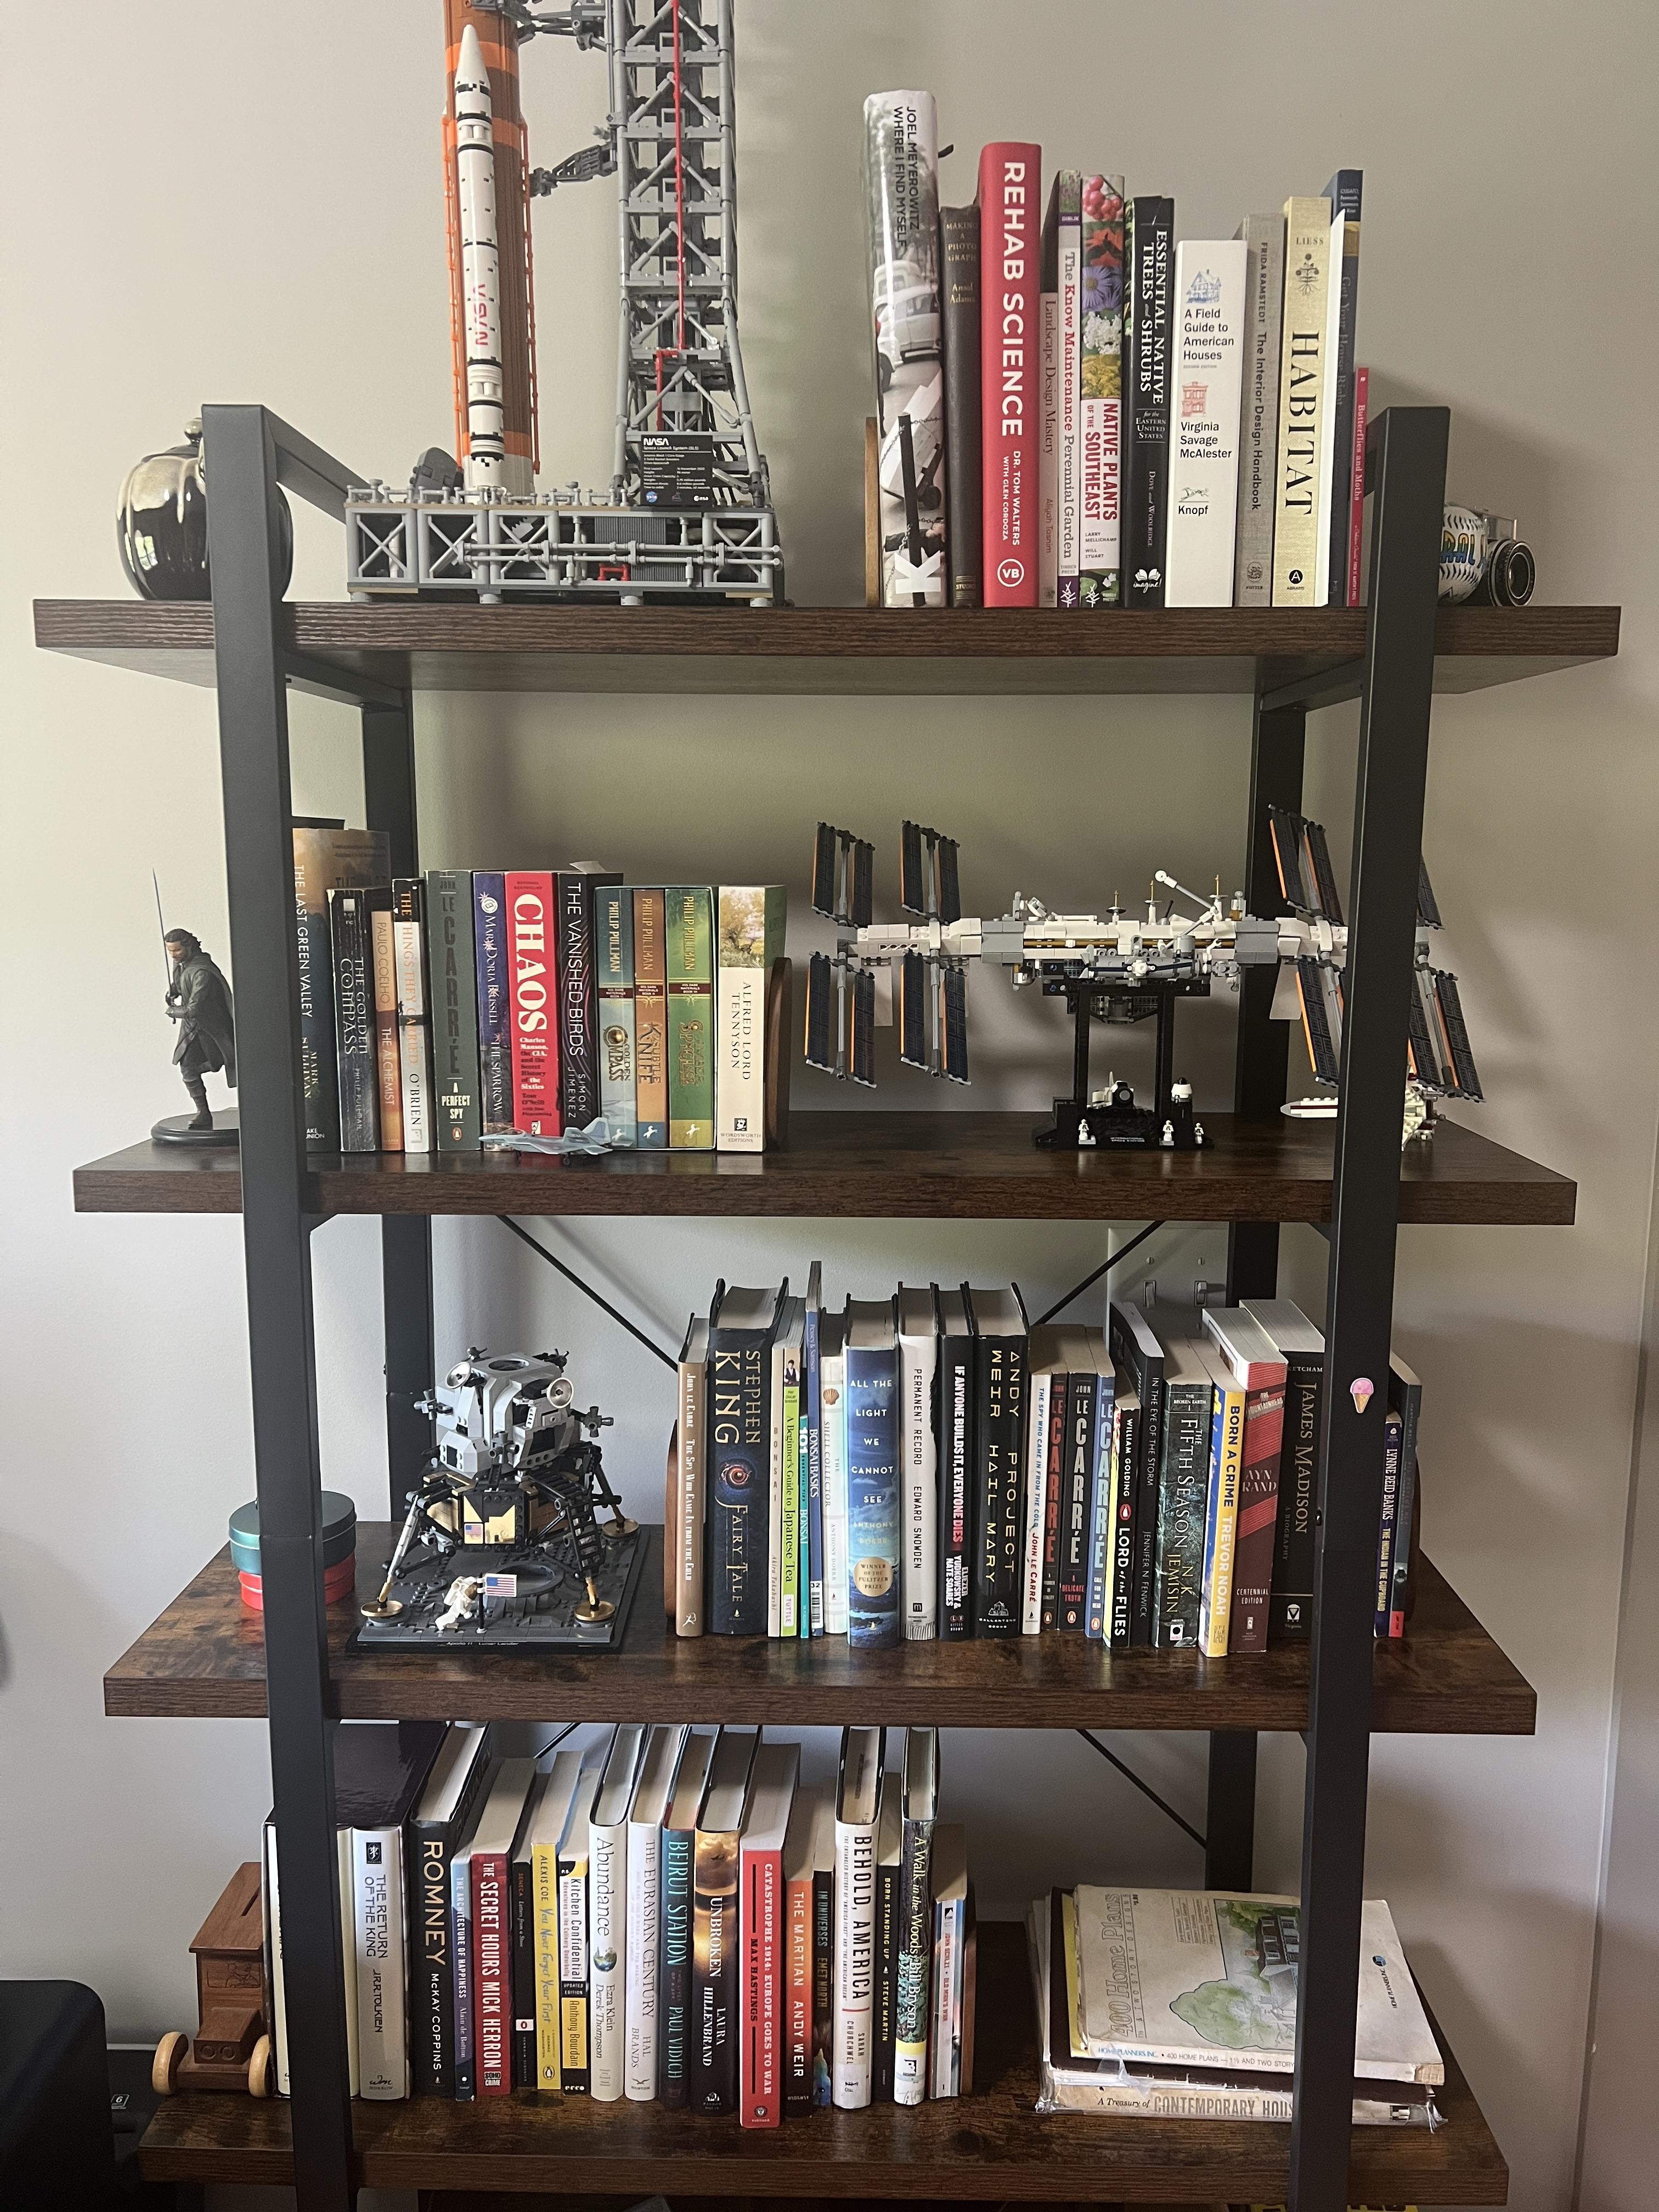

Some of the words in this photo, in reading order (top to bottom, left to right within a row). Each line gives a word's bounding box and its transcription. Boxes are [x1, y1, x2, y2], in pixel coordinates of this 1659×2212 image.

[907, 106, 917, 139] JOEL
[909, 143, 919, 231] MEYEROWITZ
[1003, 161, 1025, 281] REHAB
[1295, 236, 1324, 245] LIESS
[1065, 252, 1075, 280] The
[1260, 242, 1268, 270] FRIDA
[952, 284, 973, 293] Ansel
[1154, 230, 1167, 329] ESSENTIAL
[1257, 273, 1267, 323] RAMSTEDT
[1065, 284, 1075, 327] Know
[1043, 301, 1058, 363] Landscape
[1183, 336, 1234, 346] American
[1256, 331, 1267, 355] The
[1001, 293, 1024, 438] SCIENCE
[1153, 336, 1164, 404] NATIVE
[1183, 350, 1222, 360] Houses
[1043, 366, 1057, 406] Design
[1064, 331, 1075, 431] Maintenance
[1254, 358, 1265, 403] Interior
[644, 438, 669, 446] NASA
[1043, 410, 1056, 455] Mastery
[1103, 403, 1118, 456] NATIVE
[1180, 422, 1220, 433] Virginia
[1180, 435, 1218, 447] Savage
[1251, 405, 1264, 447] Design
[1285, 329, 1320, 515] HABITAT
[1013, 450, 1021, 469] DR.
[1064, 435, 1074, 503] Perennial
[1180, 449, 1232, 459] McAlester
[1013, 471, 1021, 494] TOM
[1103, 462, 1118, 520] PLANTS
[1251, 450, 1263, 510] Handbook
[1012, 497, 1021, 546] WALTERS
[1045, 498, 1054, 524] Aliyah
[1178, 505, 1209, 517] Knopf
[1064, 506, 1074, 558] Garden
[295, 865, 306, 888] THE
[296, 893, 308, 922] LAST
[567, 882, 582, 915] THE
[608, 901, 620, 930] PHILIP
[641, 898, 653, 927] PHILIP
[684, 896, 695, 926] PHILIP
[297, 926, 311, 970] GREEN
[376, 922, 388, 954] PAULO
[610, 931, 620, 972] PULLMAN
[642, 928, 653, 970] PULLMAN
[684, 927, 696, 970] PULLMAN
[354, 957, 364, 986] THE
[378, 958, 391, 1004] COELHO
[514, 894, 548, 1032] CHAOS
[568, 919, 584, 1003] VANISHED
[300, 974, 313, 1018] VALLEY
[340, 958, 357, 1055] COMPASS
[742, 982, 752, 1036] ALFRED
[357, 991, 368, 1054] GOLDEN
[382, 1027, 392, 1047] THE
[568, 1008, 584, 1056] BIRDS
[731, 992, 741, 1069] TENNYSON
[311, 1051, 319, 1085] MARK
[382, 1049, 395, 1105] ALCHEMIST
[742, 1041, 752, 1080] LORD
[409, 1073, 421, 1125] O'BRIEN
[441, 1095, 471, 1107] PERFECT
[567, 1066, 576, 1118] JIMENEZ
[578, 1073, 586, 1111] SIMON
[450, 1108, 465, 1119] SPY
[715, 1350, 741, 1444] KING
[743, 1350, 761, 1444] STEPHEN
[850, 1379, 869, 1387] ALL
[872, 1379, 893, 1387] THE
[913, 1368, 922, 1423] PERMANENT
[990, 1350, 1002, 1417] WEIR
[1009, 1351, 1020, 1417] ANDY
[1228, 1406, 1240, 1445] BORN
[1294, 1382, 1317, 1438] JAMES
[864, 1437, 880, 1446] WE
[913, 1429, 922, 1465] RECORD
[1125, 1418, 1133, 1454] WILLIAM
[1194, 1429, 1203, 1445] THE
[1227, 1449, 1237, 1460] A
[851, 1465, 894, 1474] CANNOT
[1123, 1458, 1131, 1497] GOLDING
[1385, 1448, 1398, 1474] LYNNE
[913, 1486, 922, 1521] EDWARD
[1223, 1464, 1236, 1507] CRIME
[1242, 1481, 1277, 1492] RAND
[1295, 1445, 1314, 1533] MADISON
[1384, 1475, 1396, 1492] REID
[1005, 1452, 1018, 1573] PROJECT
[1382, 1494, 1395, 1520] BANKS
[913, 1527, 922, 1568] SNOWDEN
[1031, 1532, 1040, 1556] JOHN
[1218, 1515, 1233, 1571] TREVOR
[945, 1558, 954, 1577] NATE
[1031, 1559, 1037, 1569] LE
[1165, 1553, 1182, 1613] JEMISIN
[945, 1577, 954, 1606] SOARES
[1029, 1572, 1038, 1602] CARRÉ
[1215, 1575, 1229, 1615] NOAH
[1241, 1596, 1263, 1605] EDITION
[482, 1861, 495, 1877] THE
[645, 1839, 656, 1864] THE
[667, 1840, 689, 1897] BEIRUT
[376, 1874, 387, 1901] THE
[596, 1837, 614, 1936] Abundance
[851, 1835, 872, 1910] BEHOLD,
[423, 1841, 446, 1965] ROMNEY
[479, 1881, 500, 1929] SECRET
[571, 1878, 582, 1915] Kitchen
[643, 1867, 656, 1942] EURASIAN
[794, 1892, 804, 1917] THE
[376, 1904, 388, 1959] RETURN
[667, 1904, 687, 1965] STATION
[709, 1896, 723, 1978] UNBROKEN
[1101, 1893, 1125, 1942] Plans
[480, 1933, 501, 1976] HOURS
[571, 1920, 583, 1979] Confidential
[793, 1924, 804, 1986] MARTIAN
[852, 1920, 871, 2000] AMERICA
[883, 1948, 889, 1959] UP
[642, 1948, 655, 2018] CENTURY
[1105, 1945, 1131, 1999] Home
[431, 1973, 440, 2012] McKAY
[482, 1981, 501, 2014] MICK
[568, 2000, 580, 2030] Anthony
[668, 2006, 684, 2033] PAUL
[702, 1987, 714, 2067] HILLENBRAND
[715, 2007, 726, 2046] LAURA
[793, 2001, 804, 2037] ANDY
[1108, 2000, 1133, 2038] 400
[432, 2015, 442, 2070] COPPINS
[483, 2018, 501, 2068] HERRON
[569, 2033, 580, 2067] Bourdain
[667, 2036, 684, 2078] VIDICH
[793, 2043, 804, 2076] WEIR
